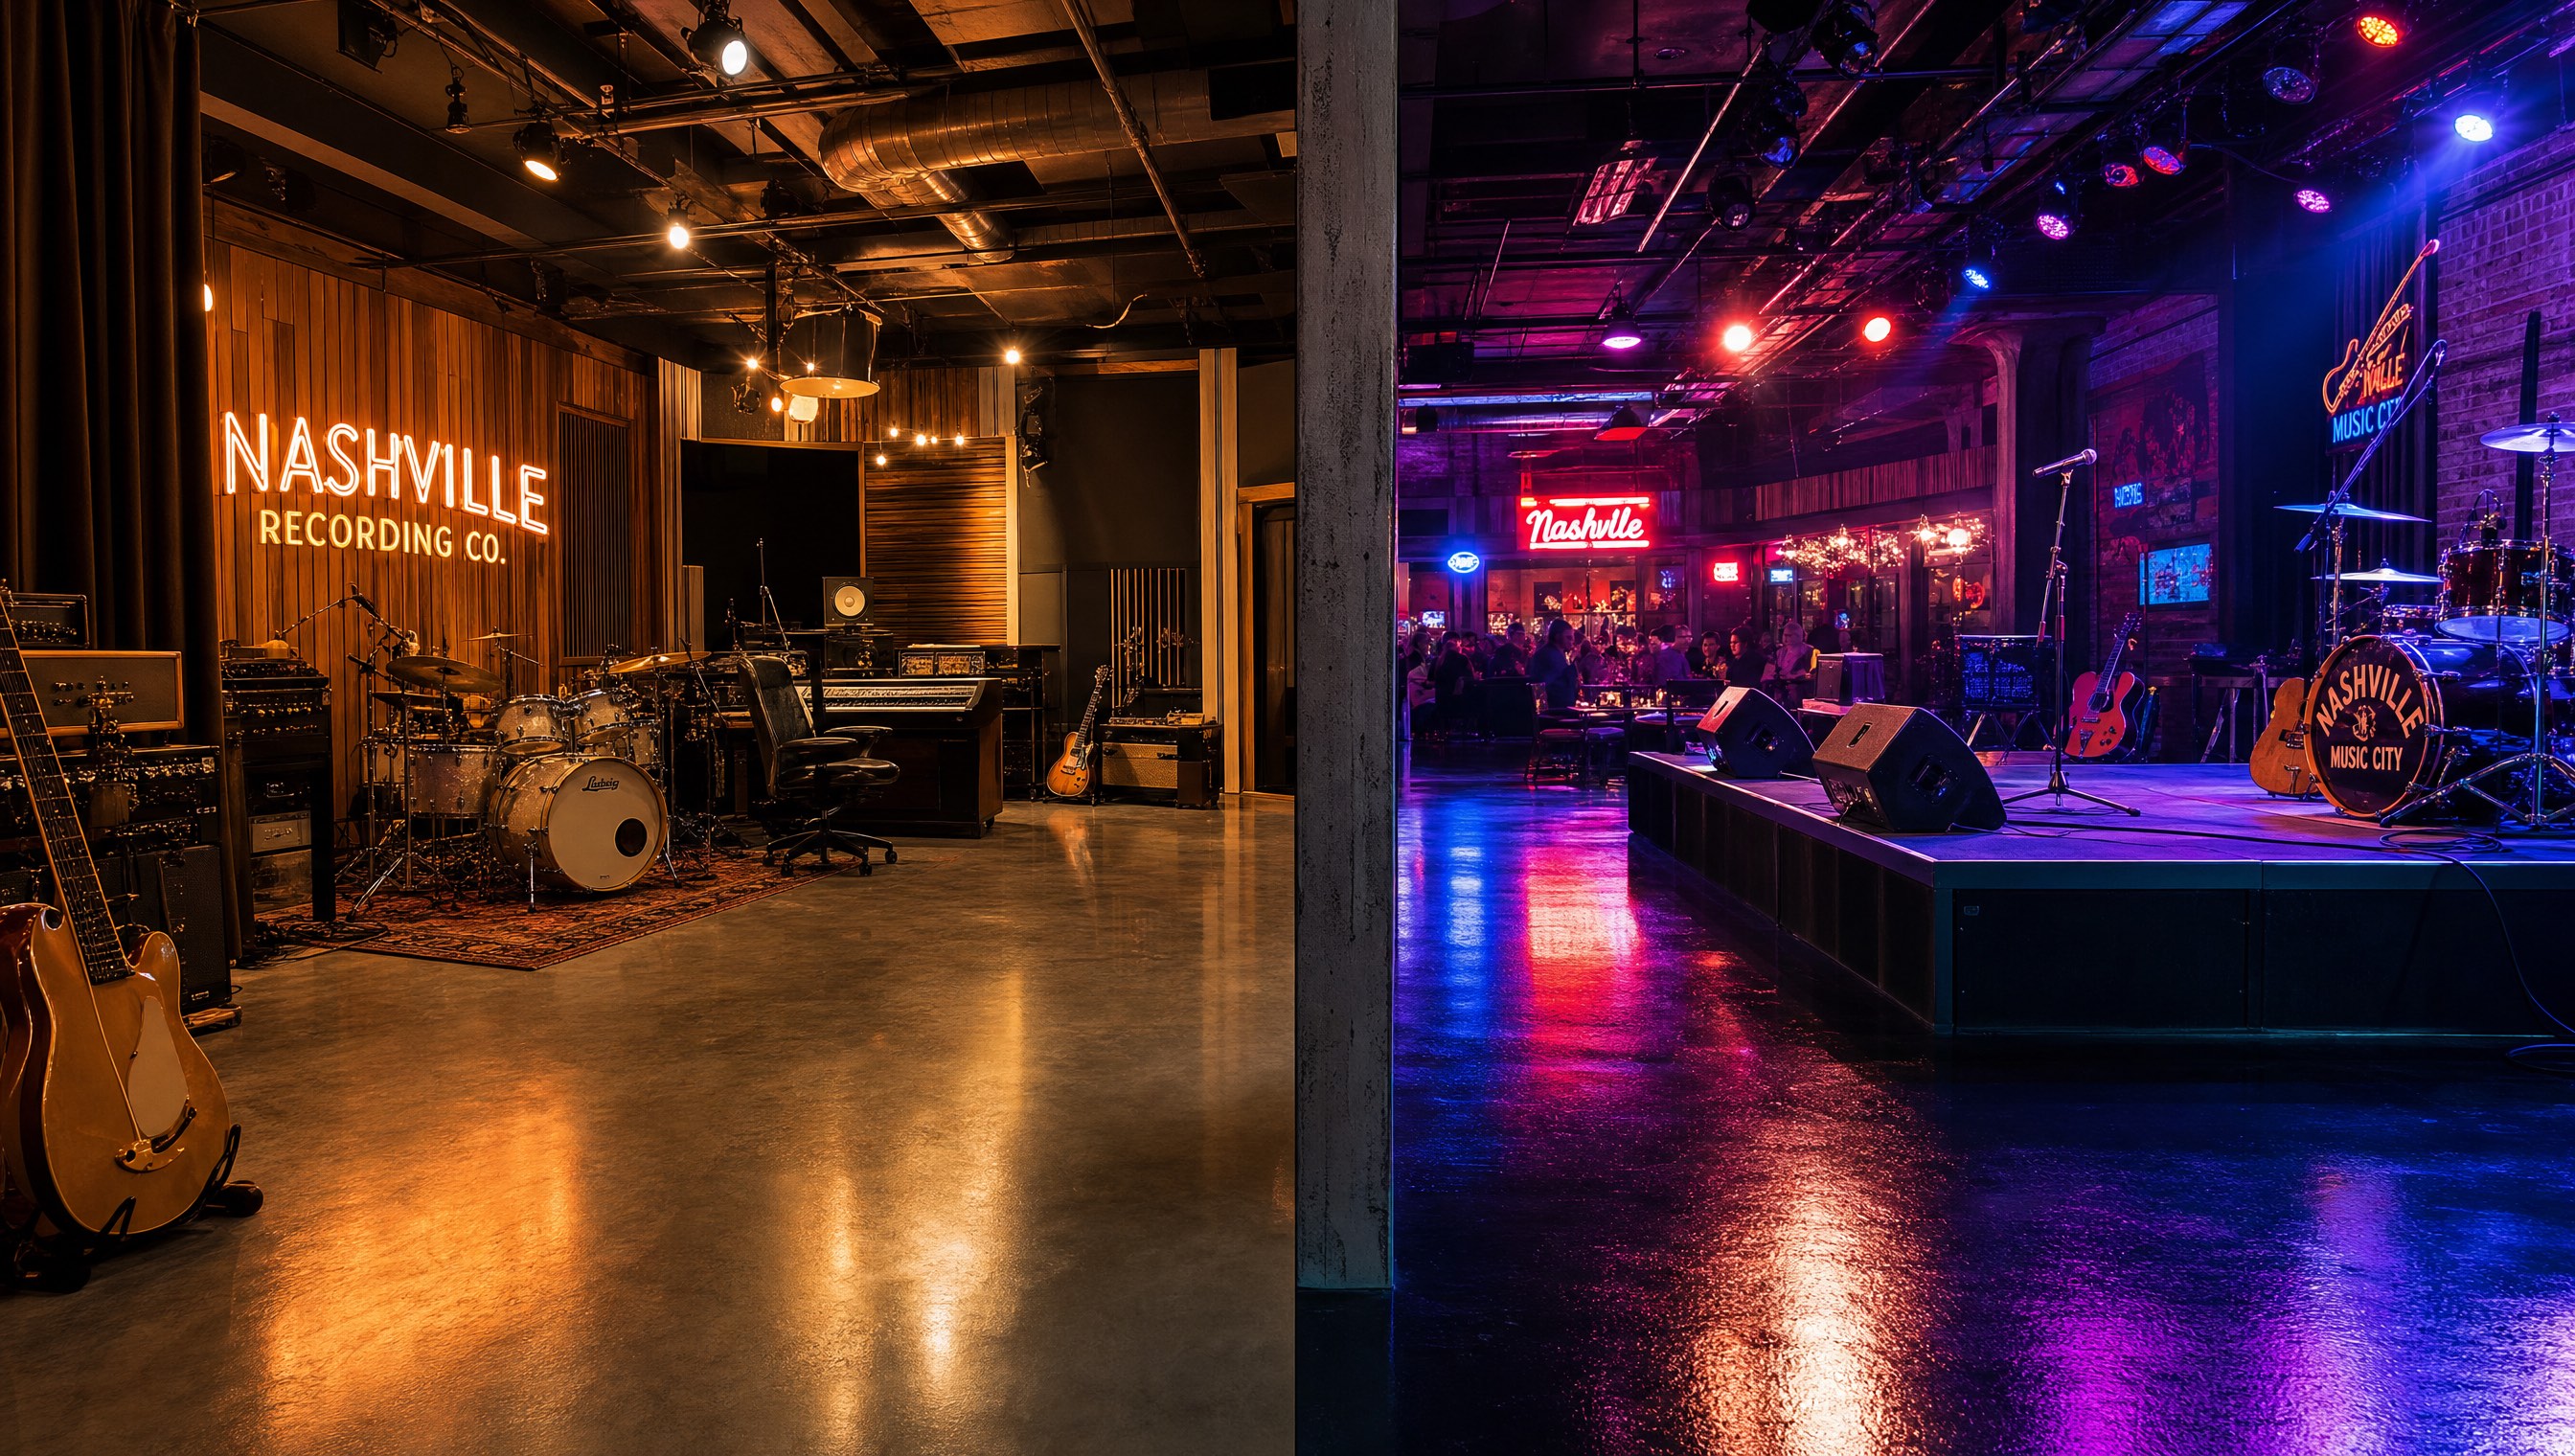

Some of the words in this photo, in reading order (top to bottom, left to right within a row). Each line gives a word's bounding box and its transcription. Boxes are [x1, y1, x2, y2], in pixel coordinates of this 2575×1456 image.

[2333, 406, 2374, 443] MUSIC
[2378, 397, 2402, 430] CI
[224, 411, 548, 535] NASHVILLE
[260, 510, 452, 557] RECORDING
[465, 531, 506, 564] CO.
[2316, 664, 2425, 739] NASHVILLE
[2330, 746, 2368, 769] MUSIC
[2373, 746, 2403, 771] CITY
